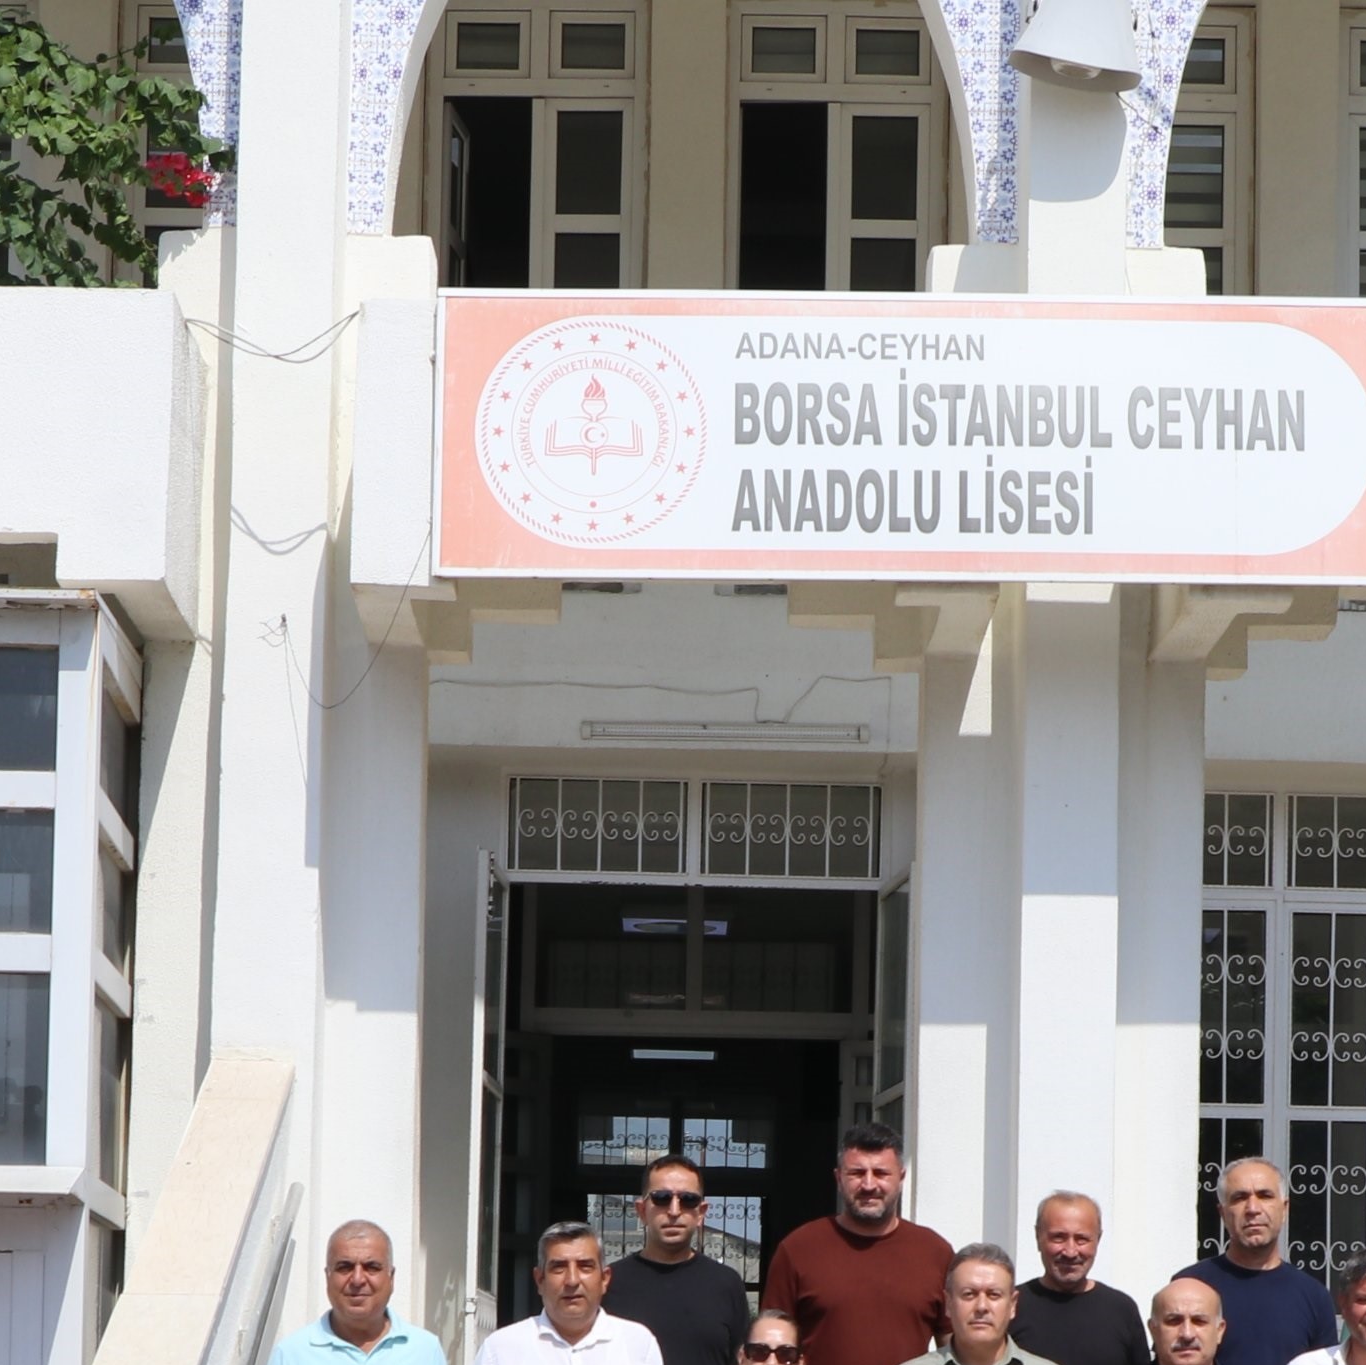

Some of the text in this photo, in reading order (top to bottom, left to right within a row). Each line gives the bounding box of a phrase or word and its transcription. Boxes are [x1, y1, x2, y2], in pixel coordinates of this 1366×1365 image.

[734, 331, 985, 361] ADANA-CEYHAN
[522, 357, 589, 414] CUMHURİYETİ
[626, 368, 660, 402] EĞİTİM
[734, 367, 1306, 451] BORSA İSTANBUL CEYHAN
[516, 416, 536, 468] TÜRKİYE
[651, 402, 670, 468] BAKANLIĞI
[731, 454, 1094, 536] ANADOLU LİSESİ
